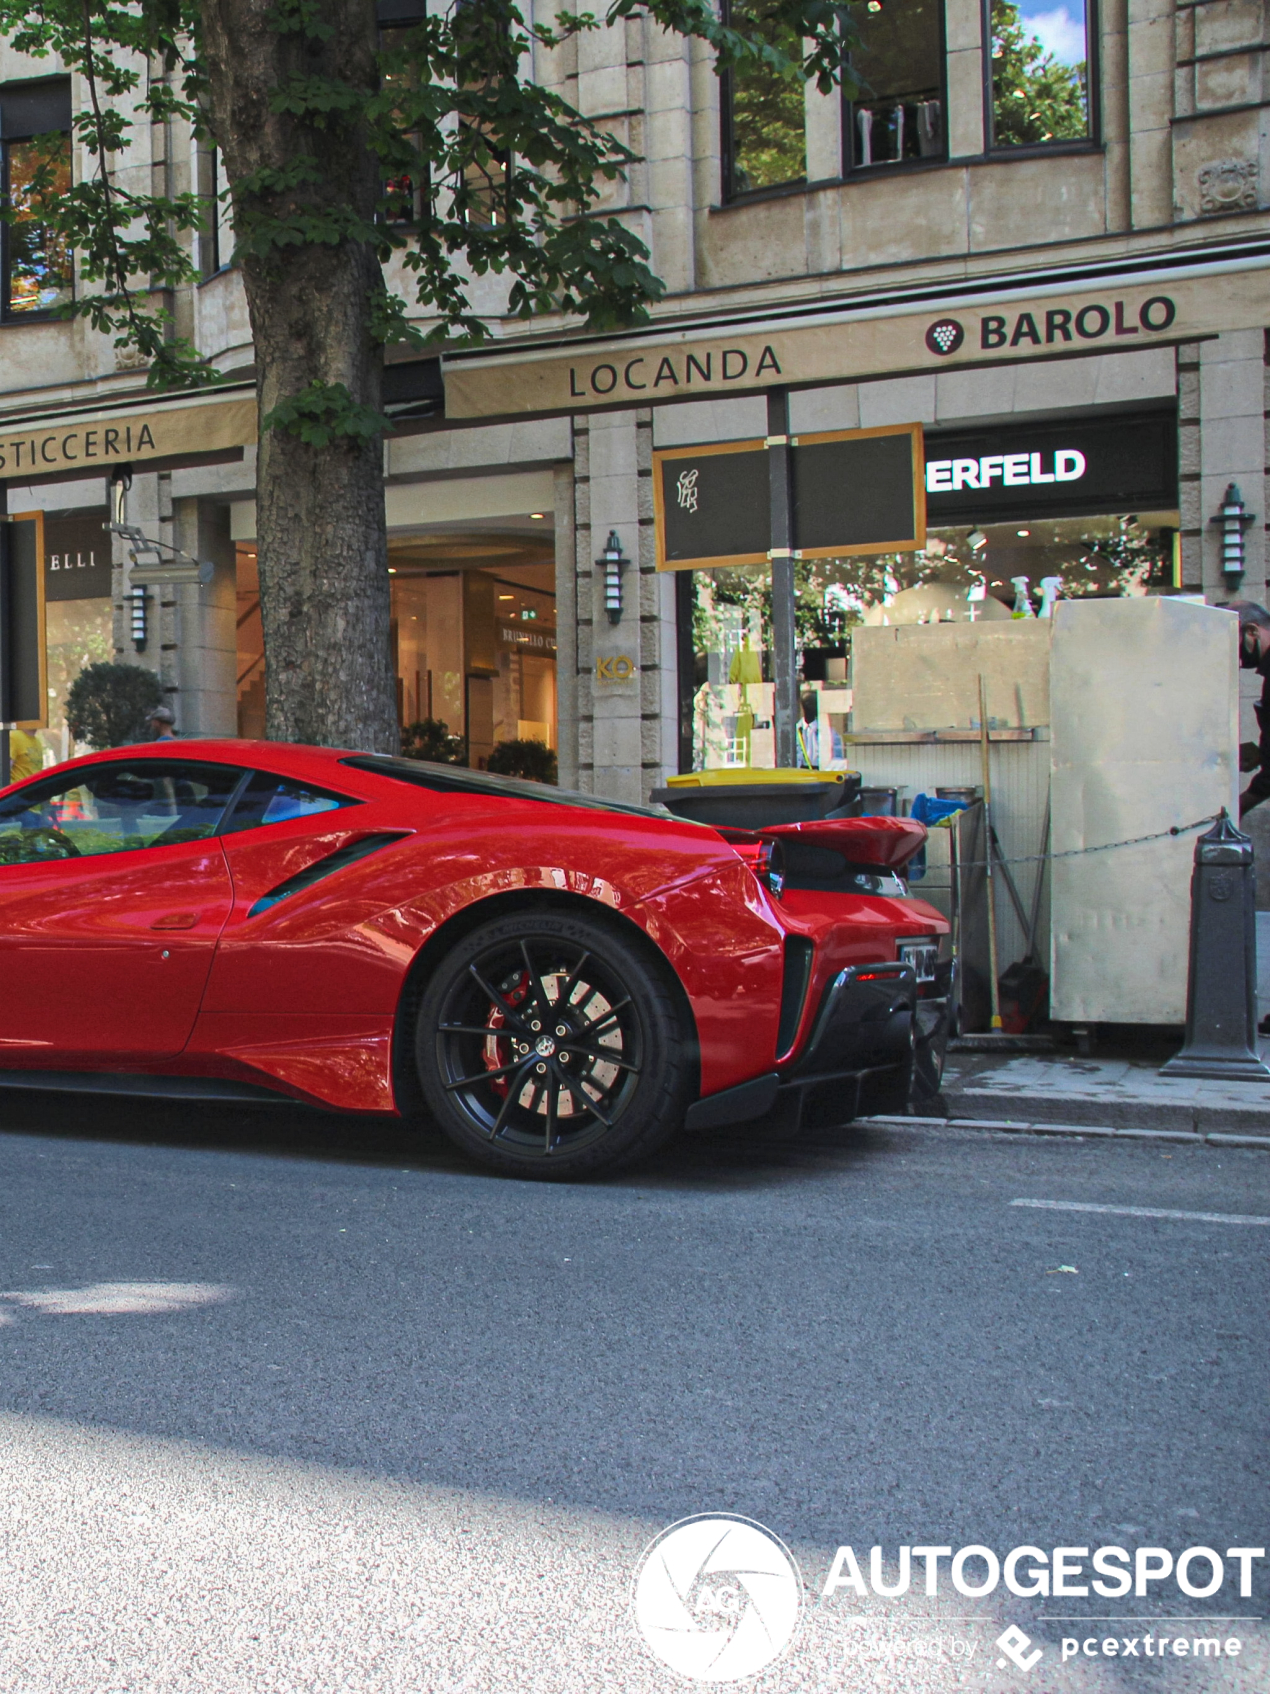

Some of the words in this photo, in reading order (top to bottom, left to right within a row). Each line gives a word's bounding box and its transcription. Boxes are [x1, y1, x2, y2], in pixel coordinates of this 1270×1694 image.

[980, 296, 1176, 350] BAROLO
[570, 345, 782, 398] LOCANDA
[925, 449, 1087, 493] ERFELD
